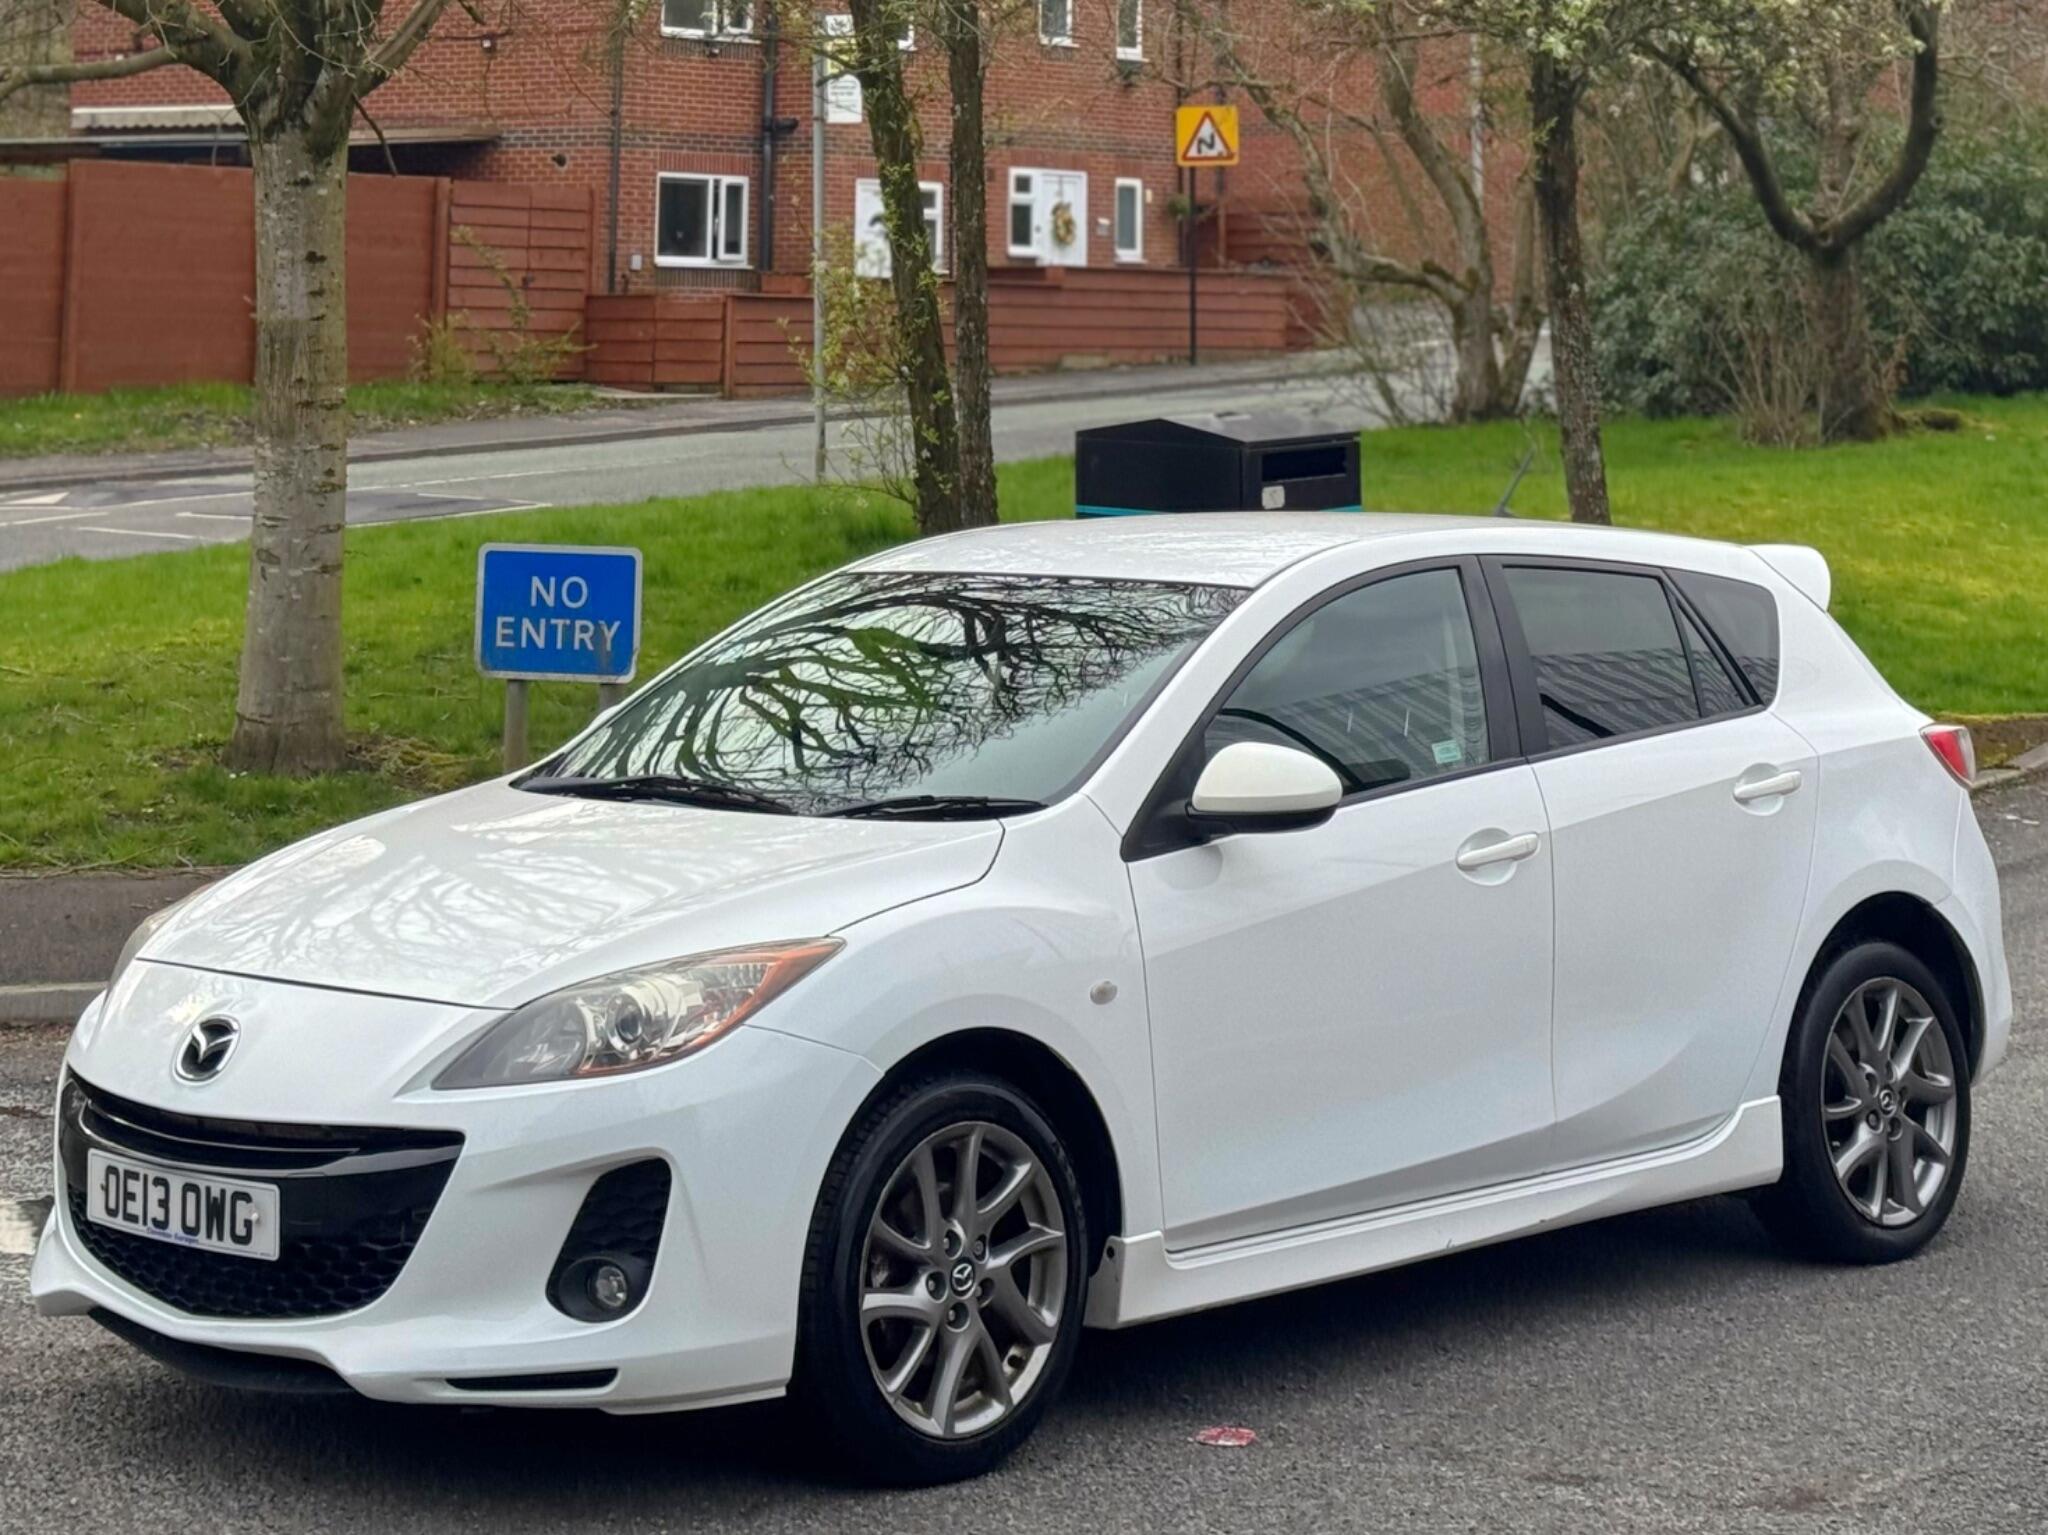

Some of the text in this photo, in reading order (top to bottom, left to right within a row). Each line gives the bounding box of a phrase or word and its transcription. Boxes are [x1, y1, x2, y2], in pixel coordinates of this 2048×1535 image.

[530, 575, 589, 609] NO
[495, 616, 621, 651] ENTRY
[104, 1164, 254, 1246] OE13 OWG
